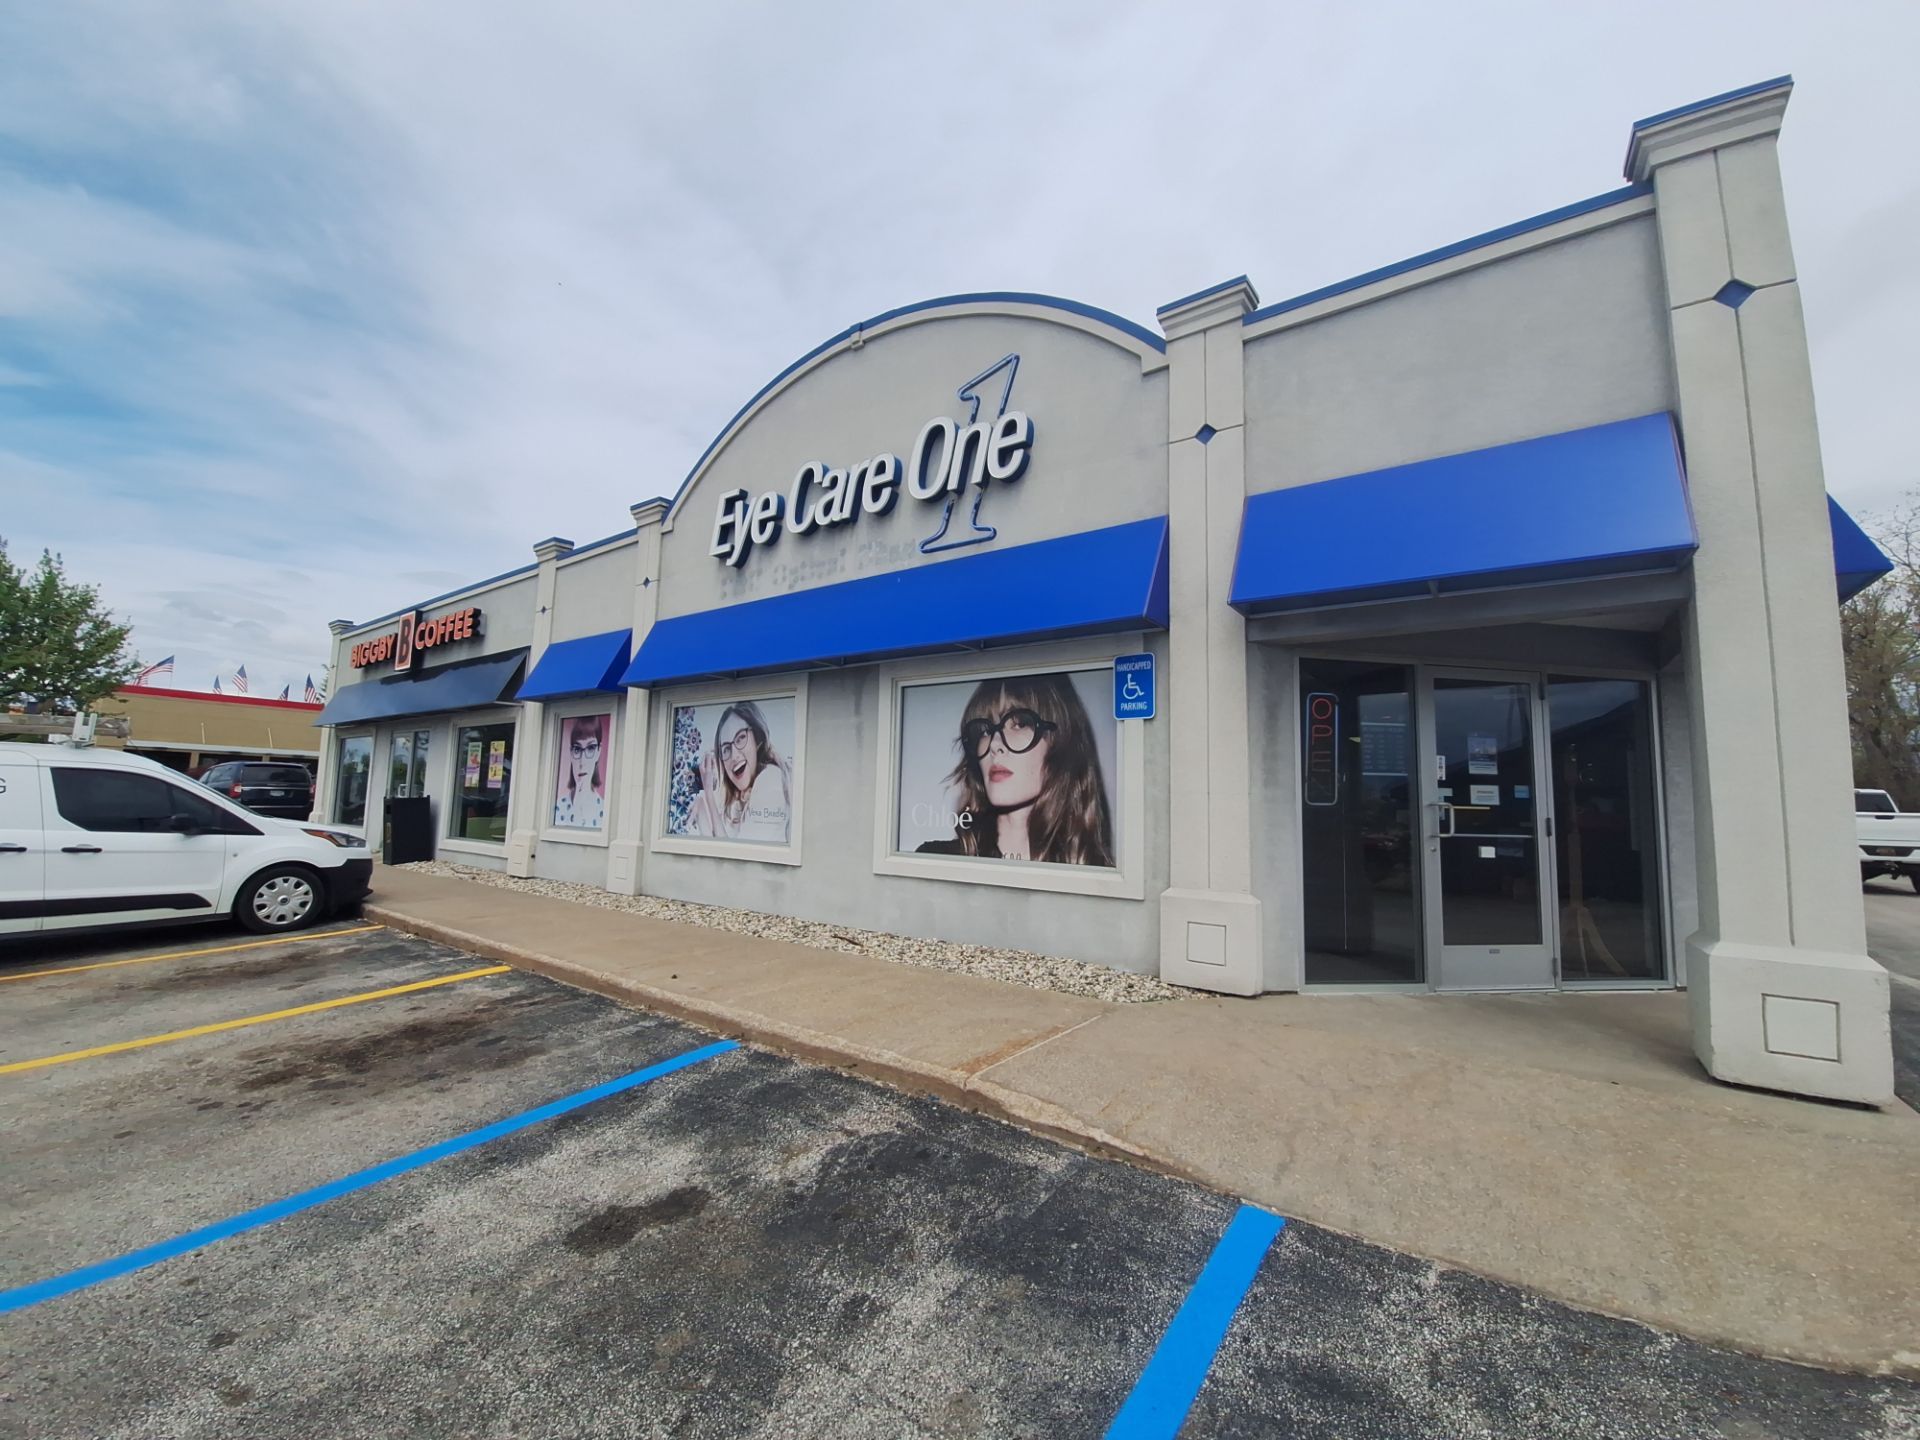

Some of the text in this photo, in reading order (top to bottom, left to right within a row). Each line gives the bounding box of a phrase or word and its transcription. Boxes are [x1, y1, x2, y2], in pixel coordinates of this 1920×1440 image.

[709, 410, 1033, 567] Eye Care One
[351, 633, 396, 669] BIGGBY
[415, 607, 478, 650] COFFEE
[1116, 661, 1151, 672] HANDICAPPED
[1120, 701, 1148, 711] PARKING
[911, 802, 974, 830] Chloé
